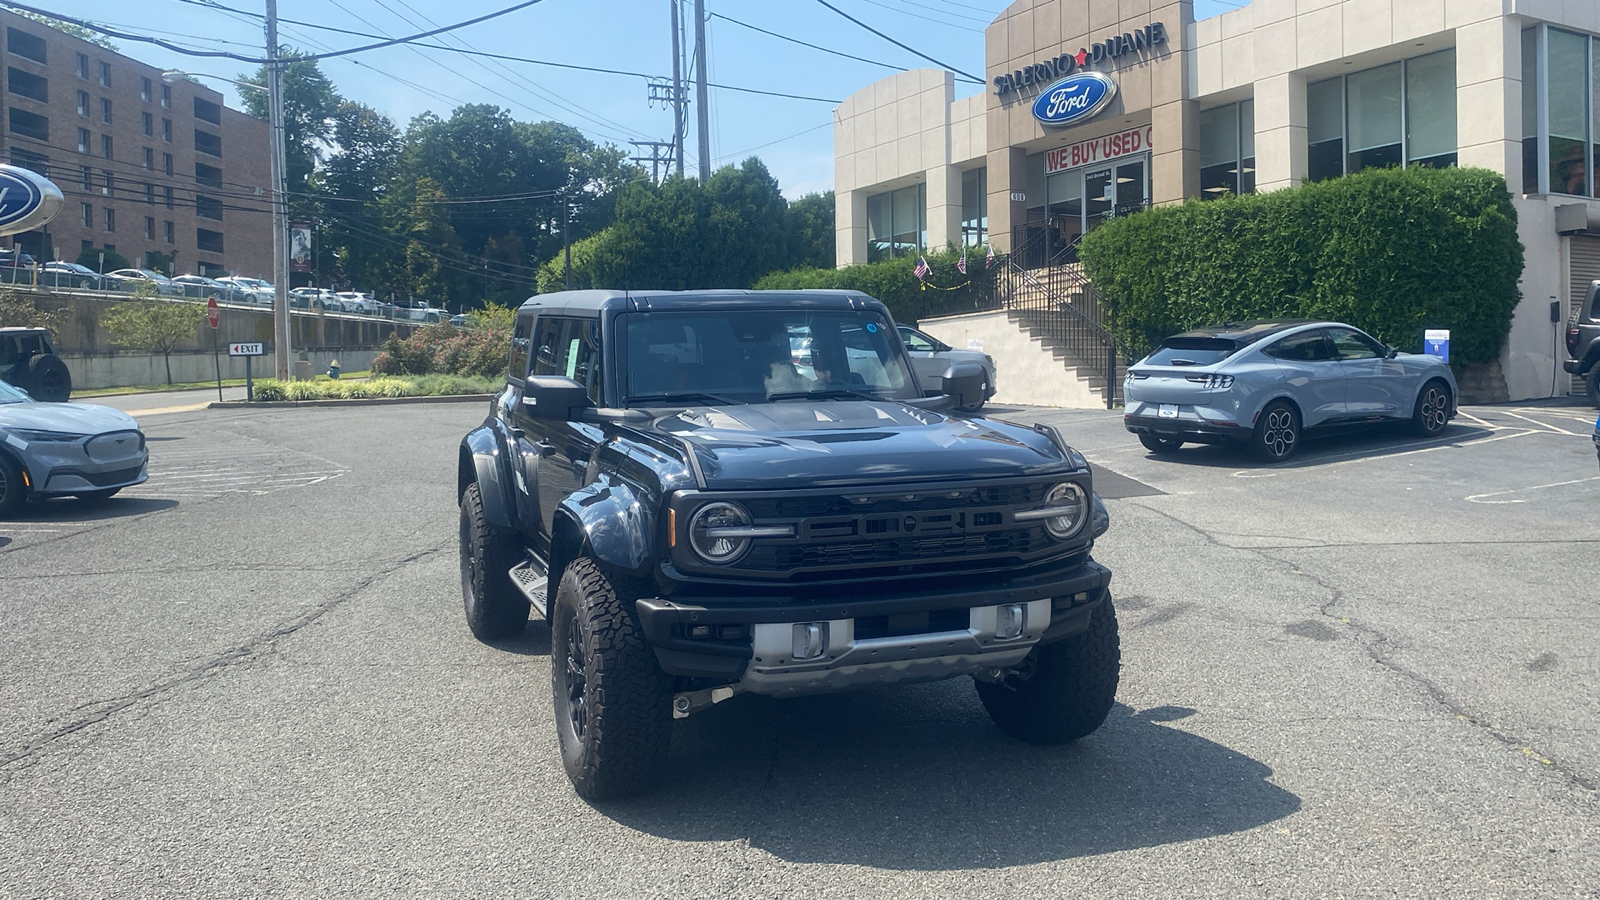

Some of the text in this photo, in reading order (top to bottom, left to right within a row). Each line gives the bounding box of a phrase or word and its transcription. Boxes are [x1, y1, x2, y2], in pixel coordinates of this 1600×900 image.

[993, 22, 1166, 95] SALERNO DUANE
[1046, 84, 1091, 117] Ford
[1047, 148, 1068, 172] WE
[1071, 140, 1099, 166] BUY
[1103, 130, 1141, 159] USED
[240, 344, 259, 353] EXIT
[799, 505, 1012, 546] FORD
